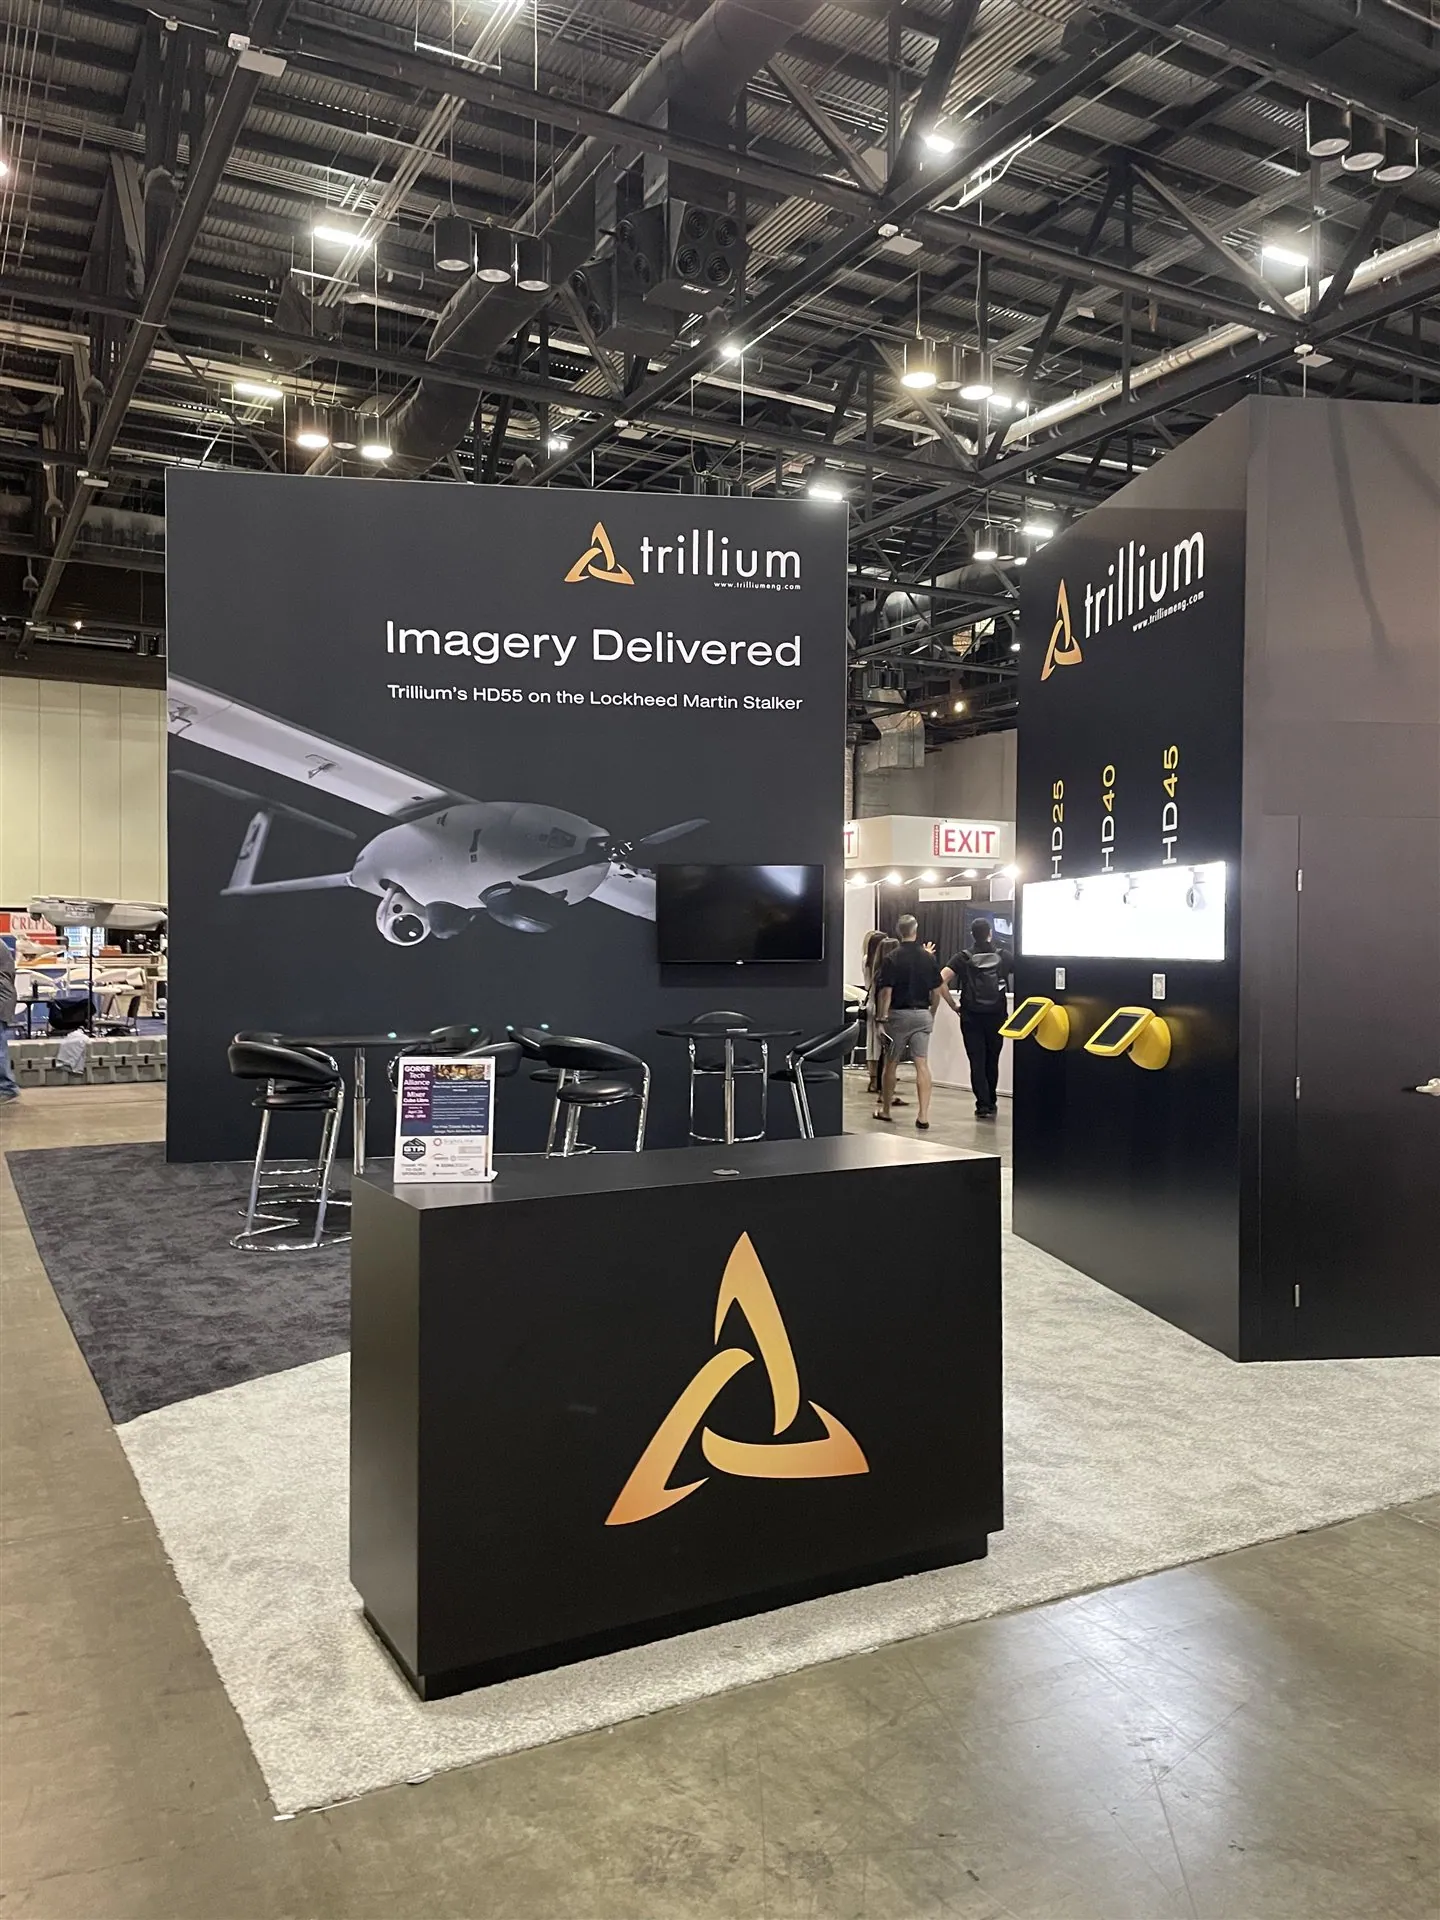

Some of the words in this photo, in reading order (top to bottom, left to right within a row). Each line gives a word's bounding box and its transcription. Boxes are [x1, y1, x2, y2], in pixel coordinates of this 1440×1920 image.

[640, 529, 801, 578] trillium
[713, 579, 801, 592] www.trilliumeng.com
[1085, 531, 1205, 639] trillium
[1132, 590, 1205, 633] www.trilliumeng.com
[386, 620, 577, 667] Imagery
[592, 628, 801, 667] Delivered
[387, 684, 468, 701] Trillium's
[473, 687, 523, 703] HD55
[528, 691, 551, 704] on
[556, 690, 585, 705] the
[590, 691, 678, 708] Lockheed
[683, 694, 738, 709] Martin
[743, 695, 804, 710] Stalker
[1102, 764, 1116, 873] HD40
[1162, 744, 1179, 865] HD45
[944, 829, 996, 854] EXIT
[1051, 779, 1064, 879] HD25
[404, 1065, 431, 1073] GORGE
[409, 1071, 426, 1079] Tech
